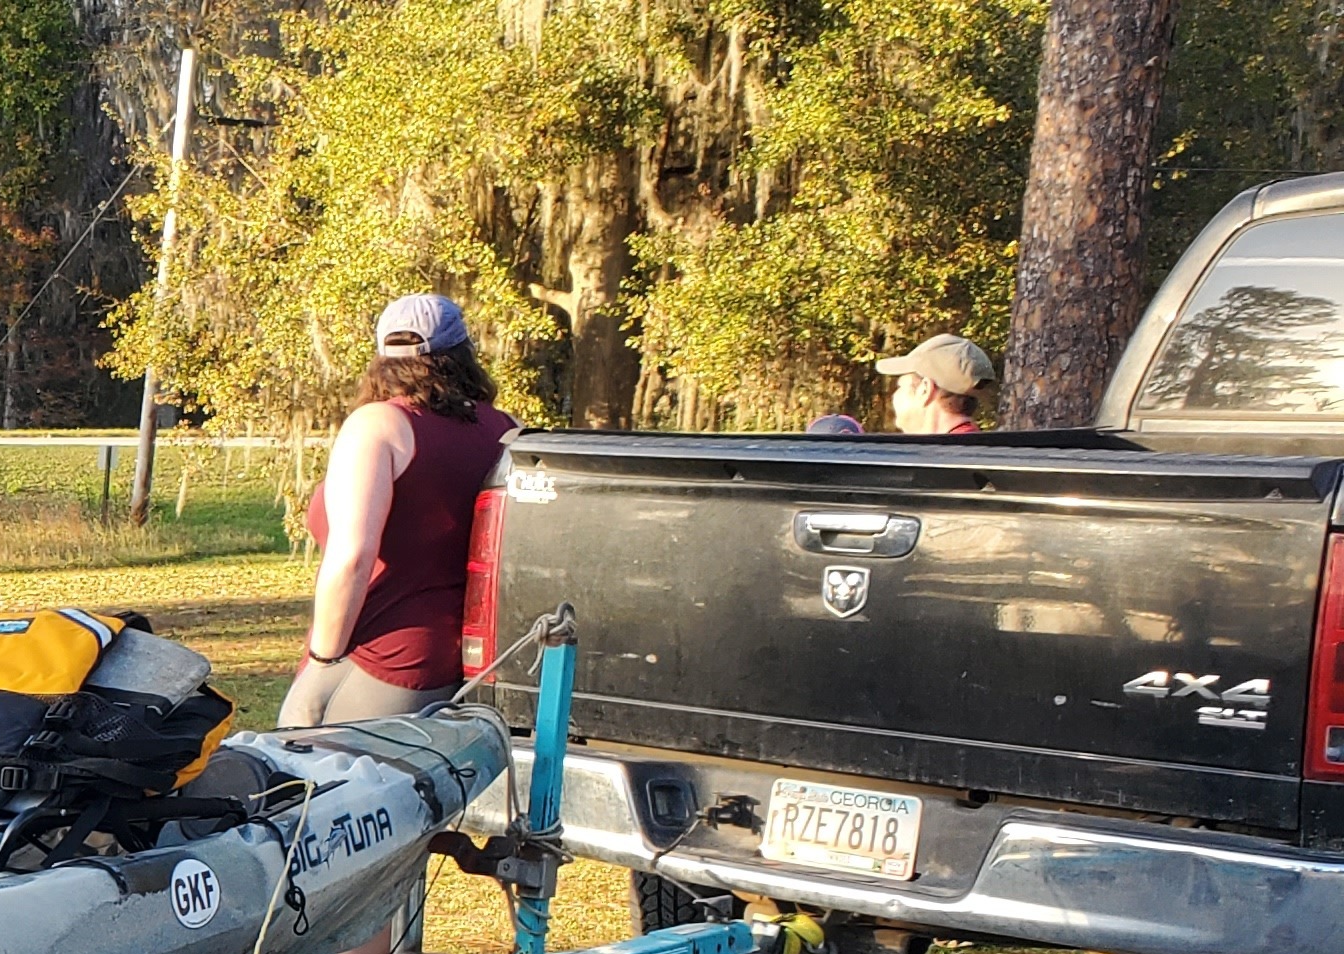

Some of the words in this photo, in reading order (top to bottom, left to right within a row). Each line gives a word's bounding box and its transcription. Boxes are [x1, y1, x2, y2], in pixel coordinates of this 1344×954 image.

[1123, 671, 1271, 707] 4X4
[830, 791, 909, 814] GEORGIA
[782, 803, 899, 855] RZE7818
[174, 869, 214, 917] GKF
